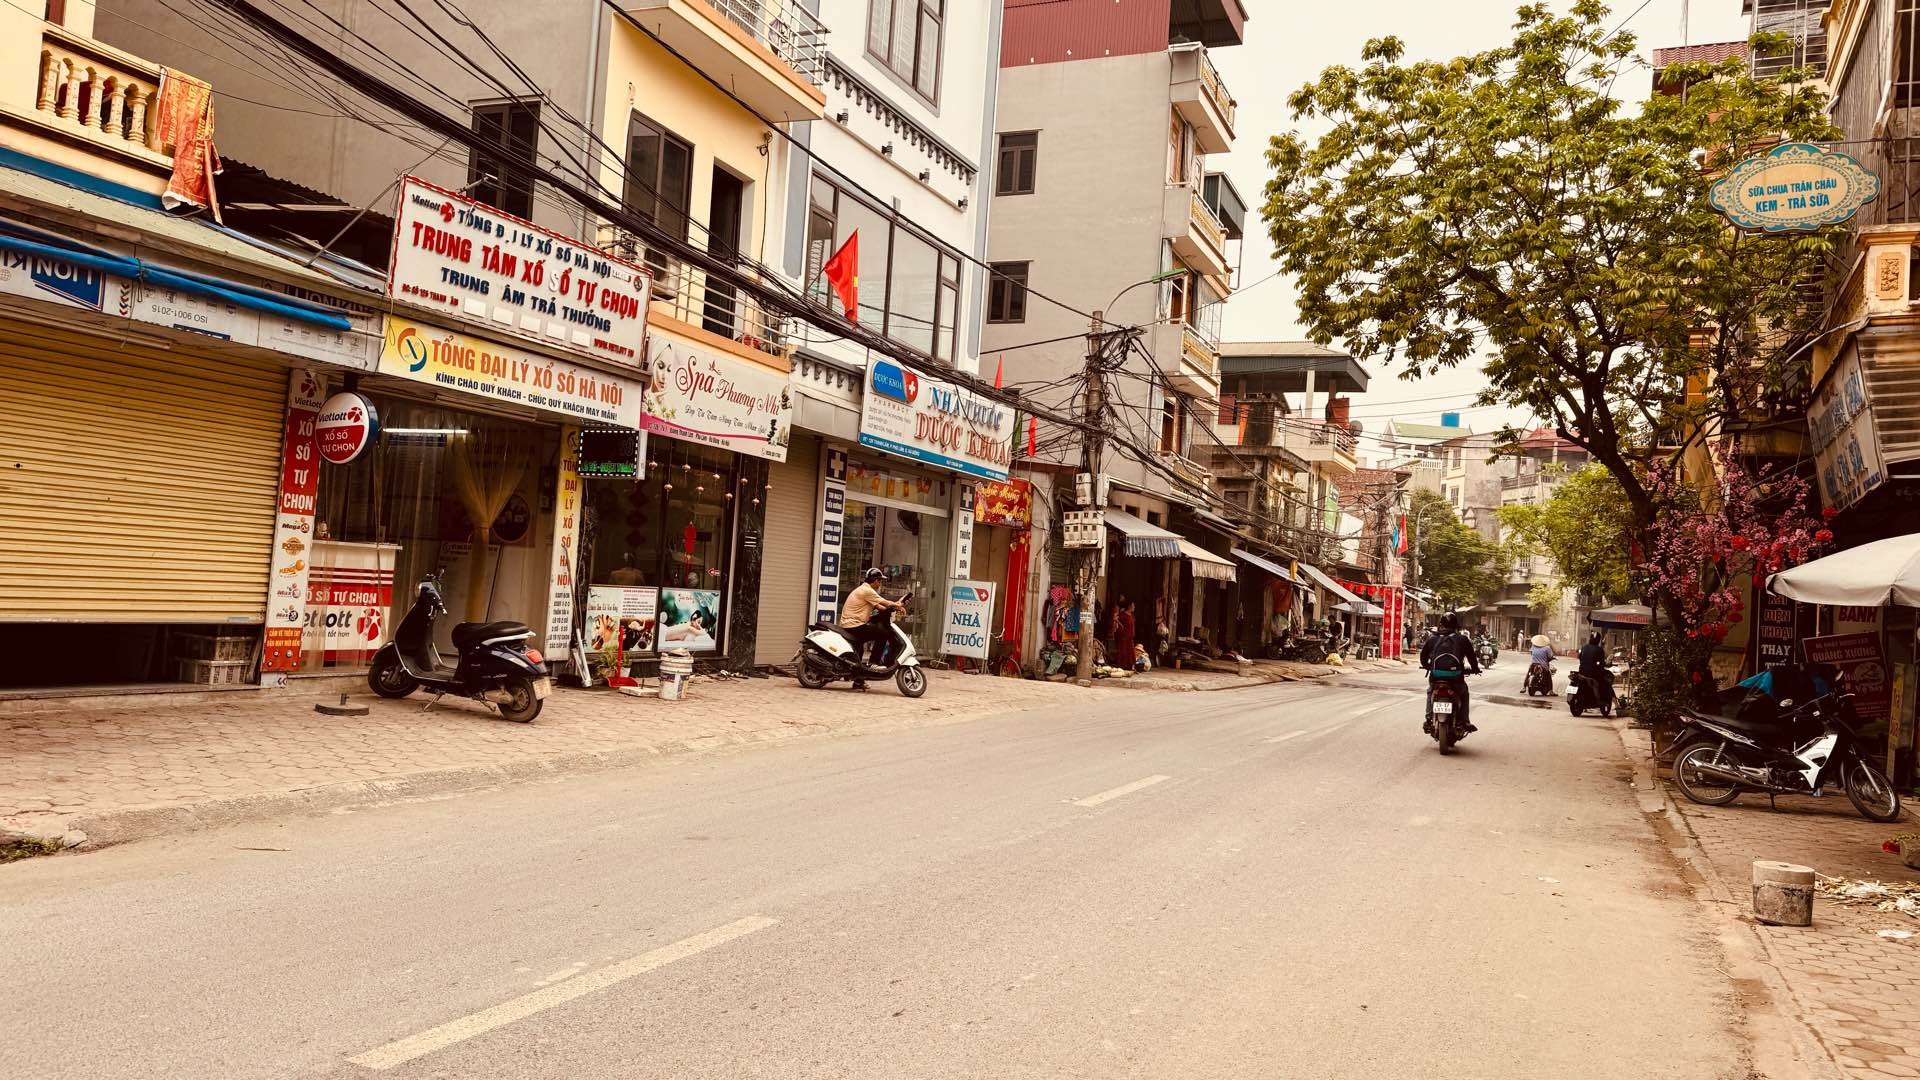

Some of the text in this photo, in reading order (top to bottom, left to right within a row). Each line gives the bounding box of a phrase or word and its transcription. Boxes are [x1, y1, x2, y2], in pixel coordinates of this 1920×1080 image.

[1767, 184, 1788, 196] CHUA
[1756, 199, 1777, 212] KEM
[556, 247, 572, 262] SỐ
[574, 253, 589, 270] HÀ
[592, 258, 612, 278] NỘI
[440, 266, 490, 295] TRUNG
[481, 242, 518, 278] TÂM
[577, 278, 598, 308] TỰ
[600, 288, 639, 320] CHỌN
[151, 304, 208, 324] ISO 9001-2015
[432, 335, 623, 408] TỔNG ĐẠI LÝ XỔ SỐ HÀ NỘI
[675, 356, 715, 400] Spa
[436, 372, 456, 386] KÍNH
[457, 378, 478, 390] CHÀO
[480, 382, 496, 394] QUÝ
[496, 386, 522, 400] KHÁCH
[528, 393, 547, 406] CHÚC
[562, 401, 584, 414] KHÁCH
[586, 406, 600, 416] MAY
[715, 379, 780, 416] Phương Nhi
[336, 430, 349, 440] SỐ
[296, 441, 312, 461] SỐ
[332, 442, 356, 452] CHỌN
[294, 468, 309, 489] TỰ
[565, 479, 578, 494] ĐẠI
[284, 492, 314, 513] CHỌN
[566, 496, 574, 510] LÝ
[560, 533, 572, 548] SỐ
[334, 590, 348, 604] TỰ
[349, 592, 377, 606] CHỌN
[952, 612, 981, 628] NHÀ
[945, 632, 984, 648] THUỐC
[1760, 644, 1792, 656] THAY
